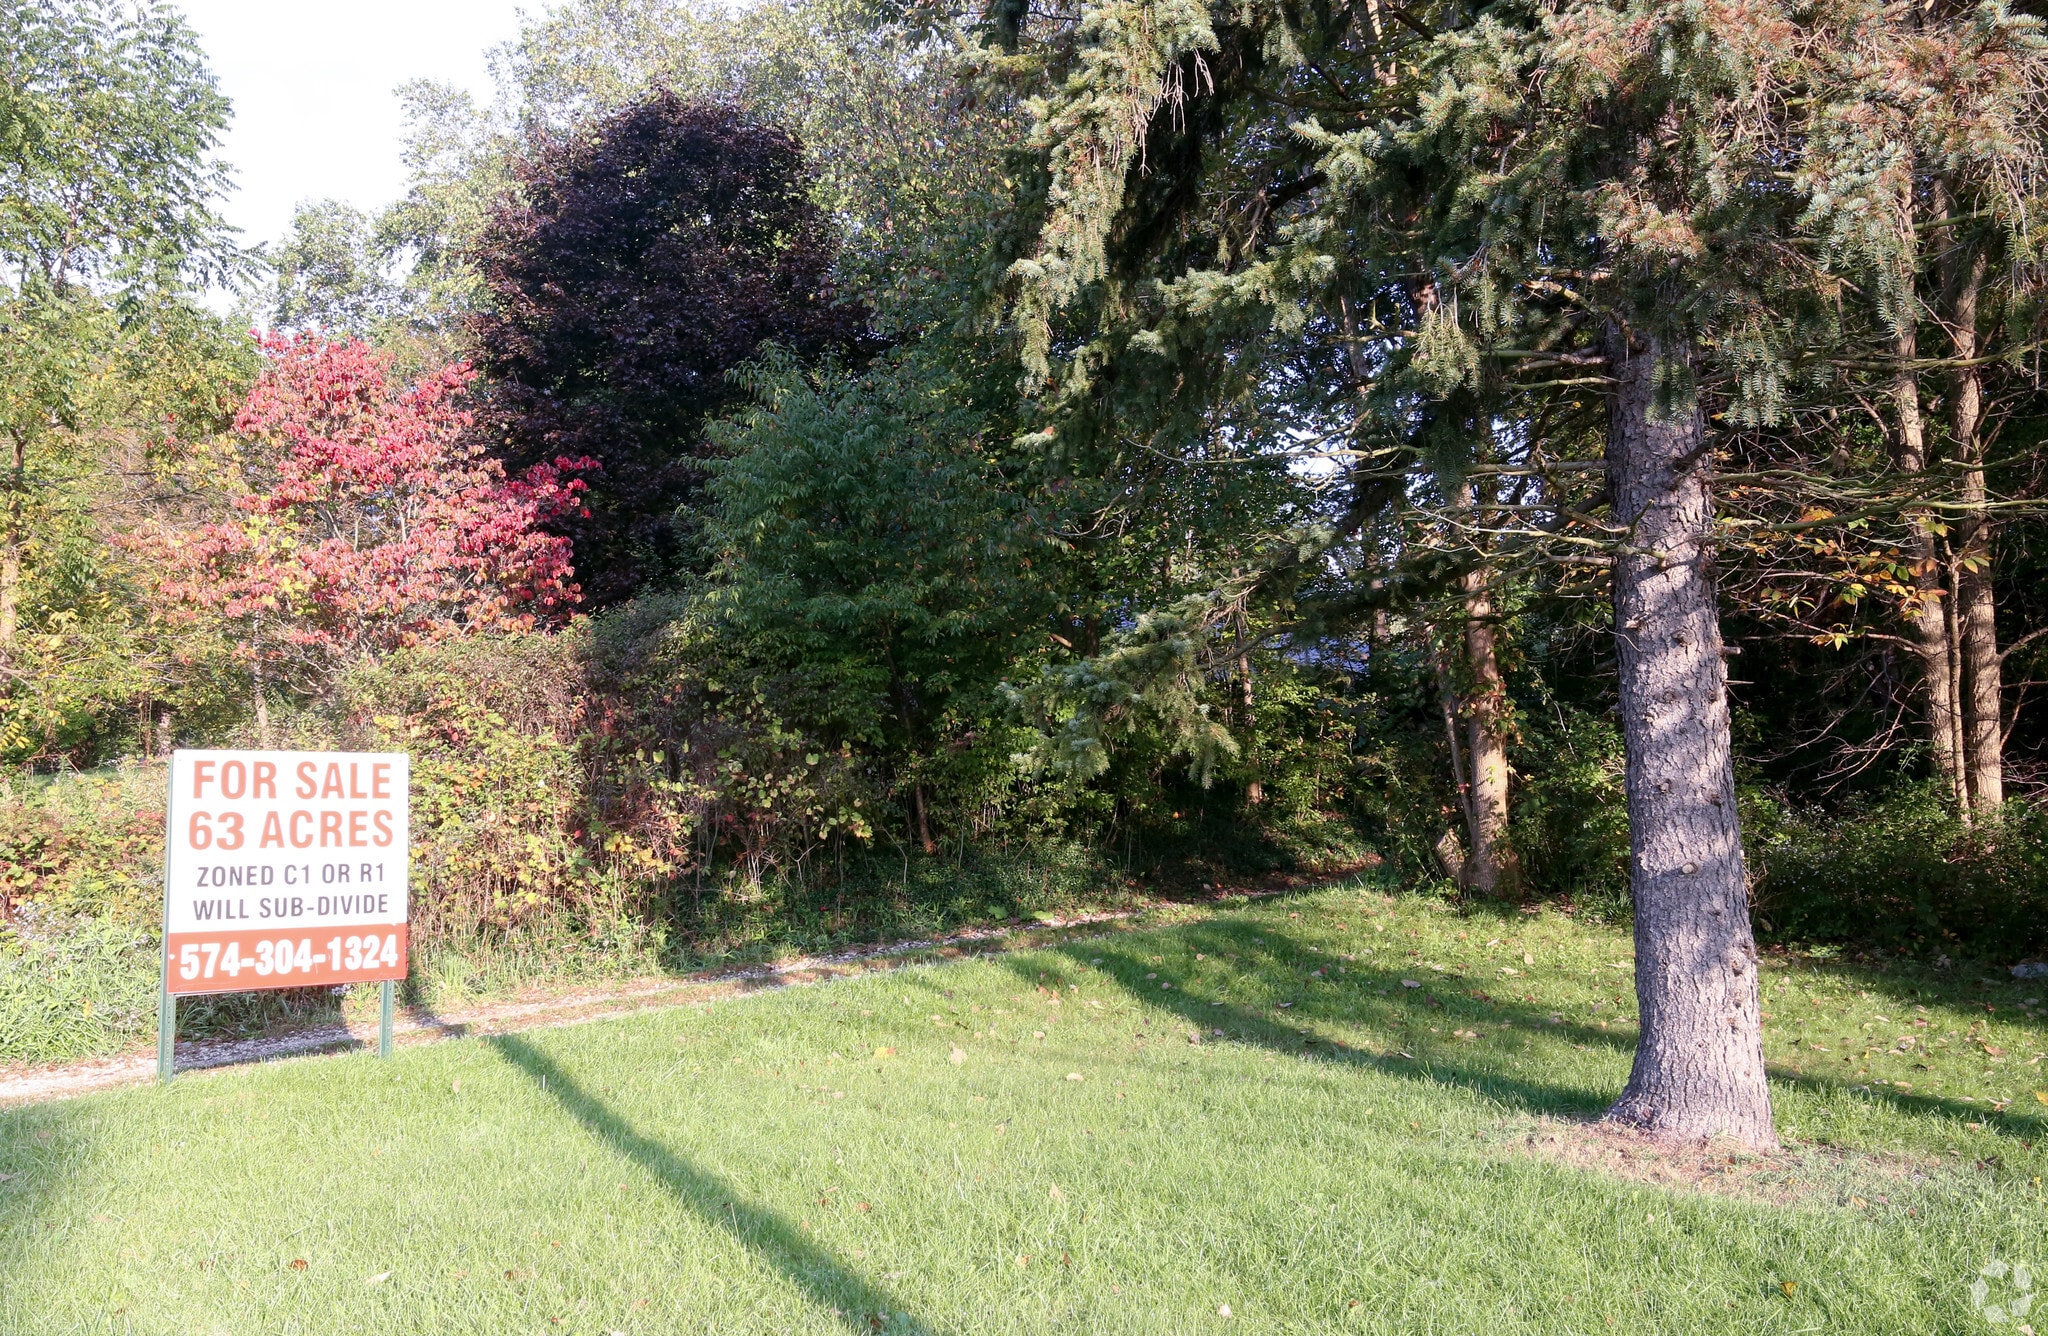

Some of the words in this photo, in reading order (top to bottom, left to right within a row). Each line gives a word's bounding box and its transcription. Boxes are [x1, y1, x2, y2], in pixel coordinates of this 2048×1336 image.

[193, 760, 277, 799] FOR
[295, 761, 391, 799] SALE
[188, 811, 245, 850] 63
[259, 809, 393, 848] ACRES
[197, 865, 274, 887] ZONED
[284, 864, 310, 885] C1
[322, 863, 350, 884] OR
[360, 863, 384, 882] R1
[193, 899, 249, 921] WILL
[259, 894, 388, 918] SUB-DIVIDE
[179, 934, 398, 980] 574-304-1324
